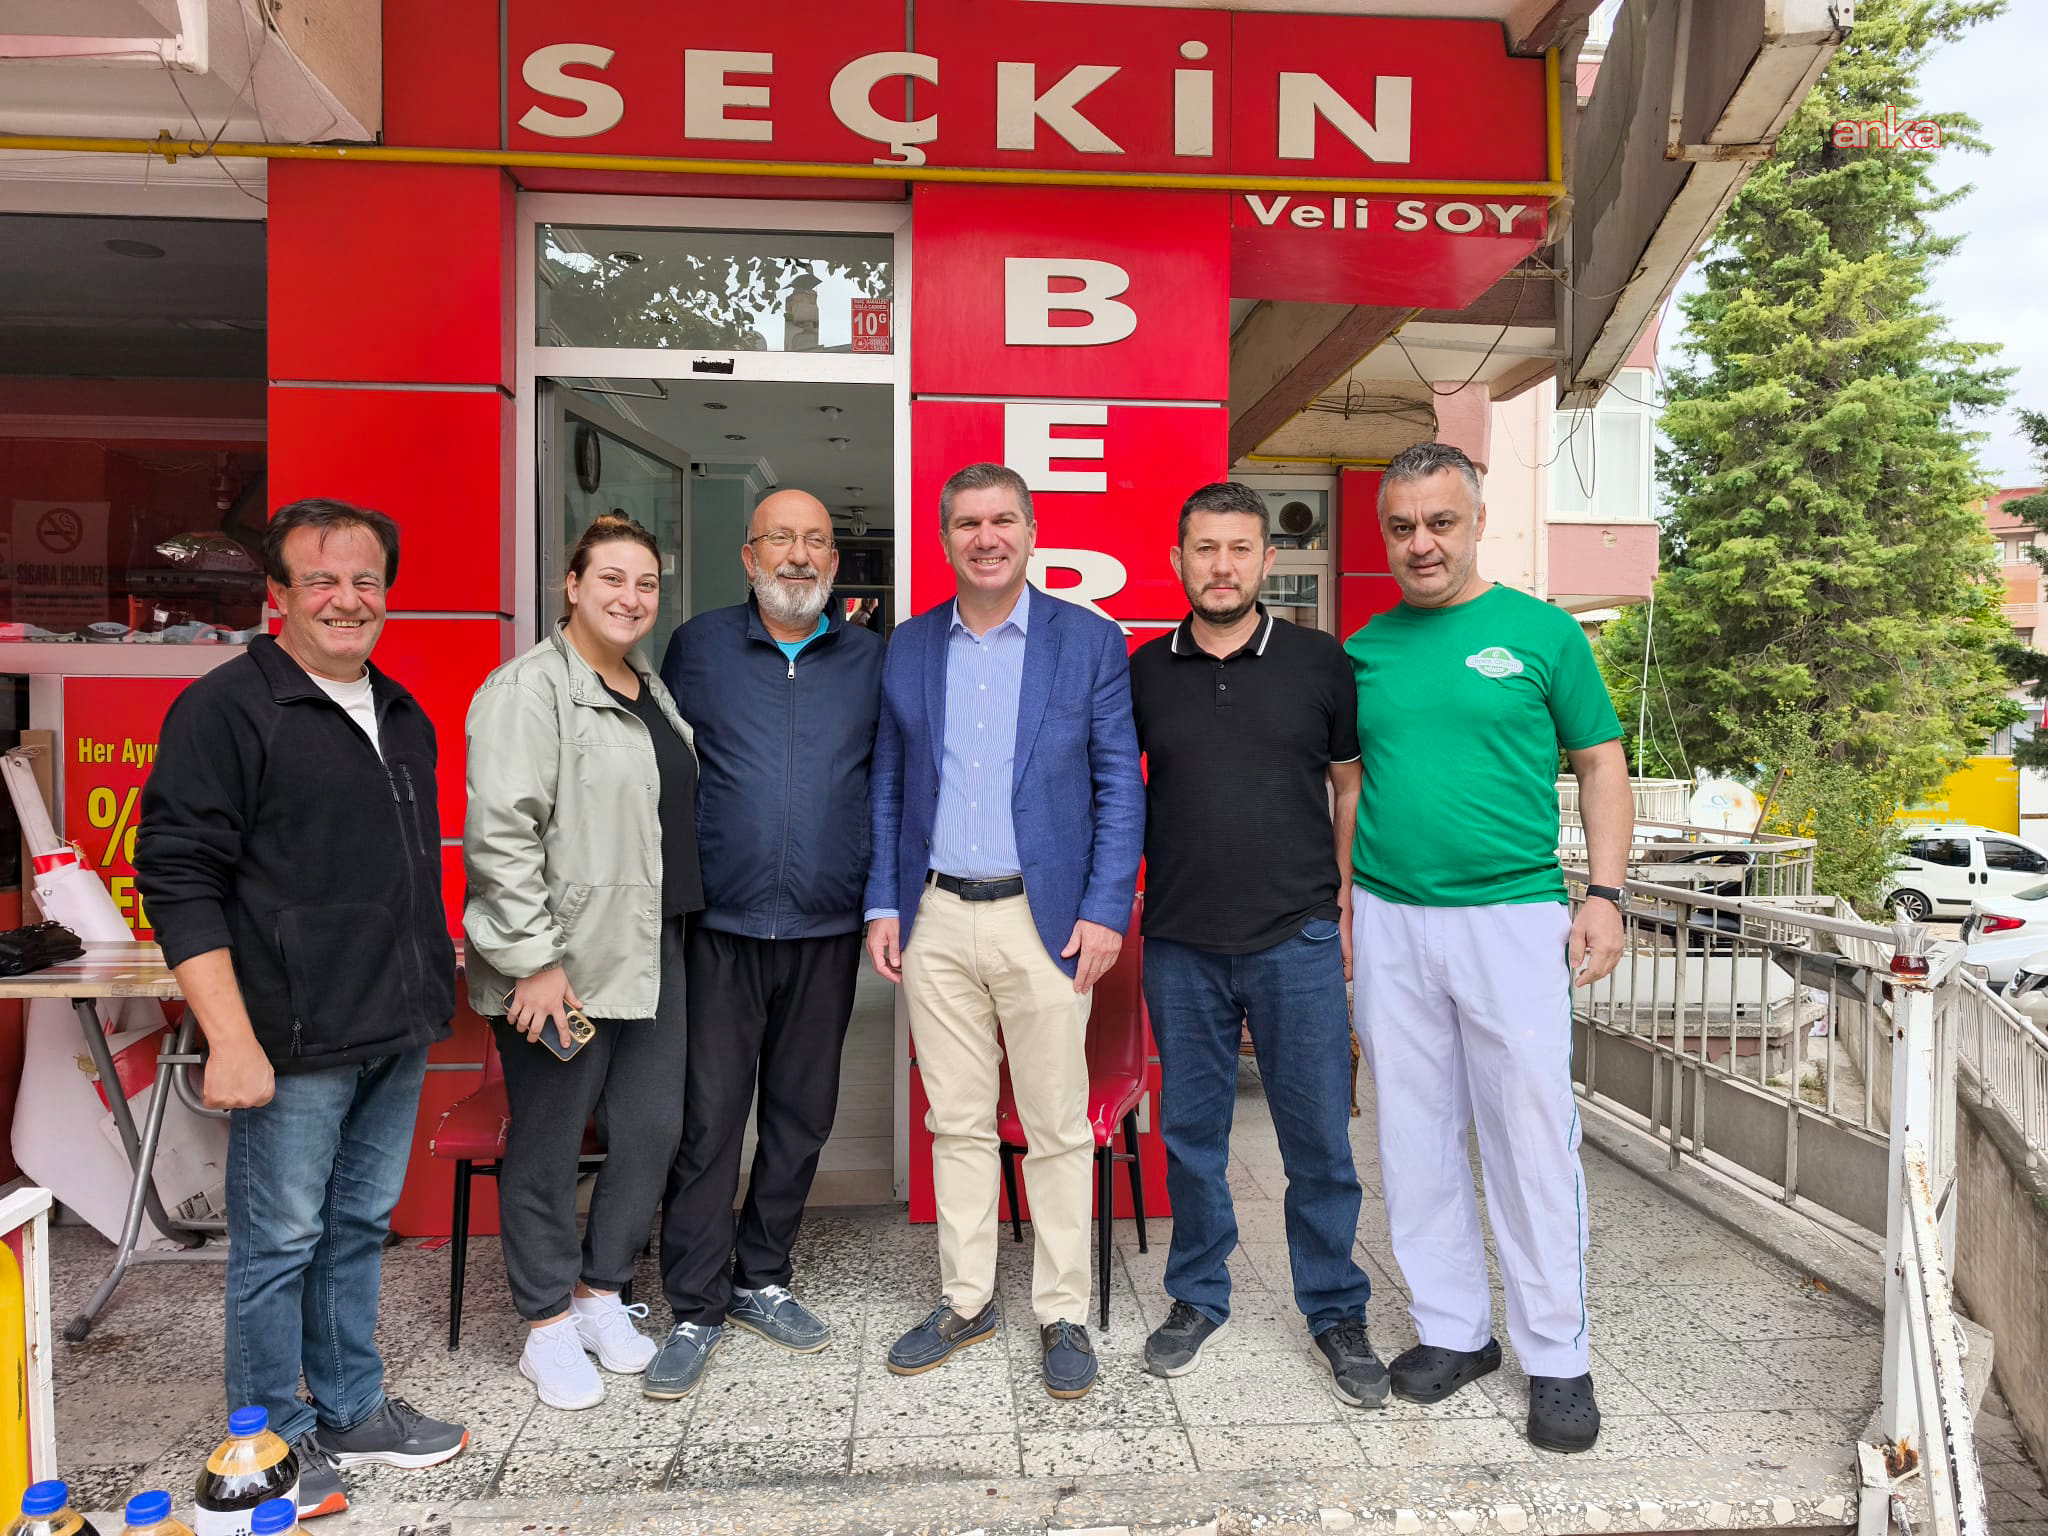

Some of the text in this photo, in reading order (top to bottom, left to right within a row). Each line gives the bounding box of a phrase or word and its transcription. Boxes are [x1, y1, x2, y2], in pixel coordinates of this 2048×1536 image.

[518, 40, 1412, 166] SEÇKİN
[1245, 194, 1527, 234] Veli SOY
[78, 737, 115, 763] Her
